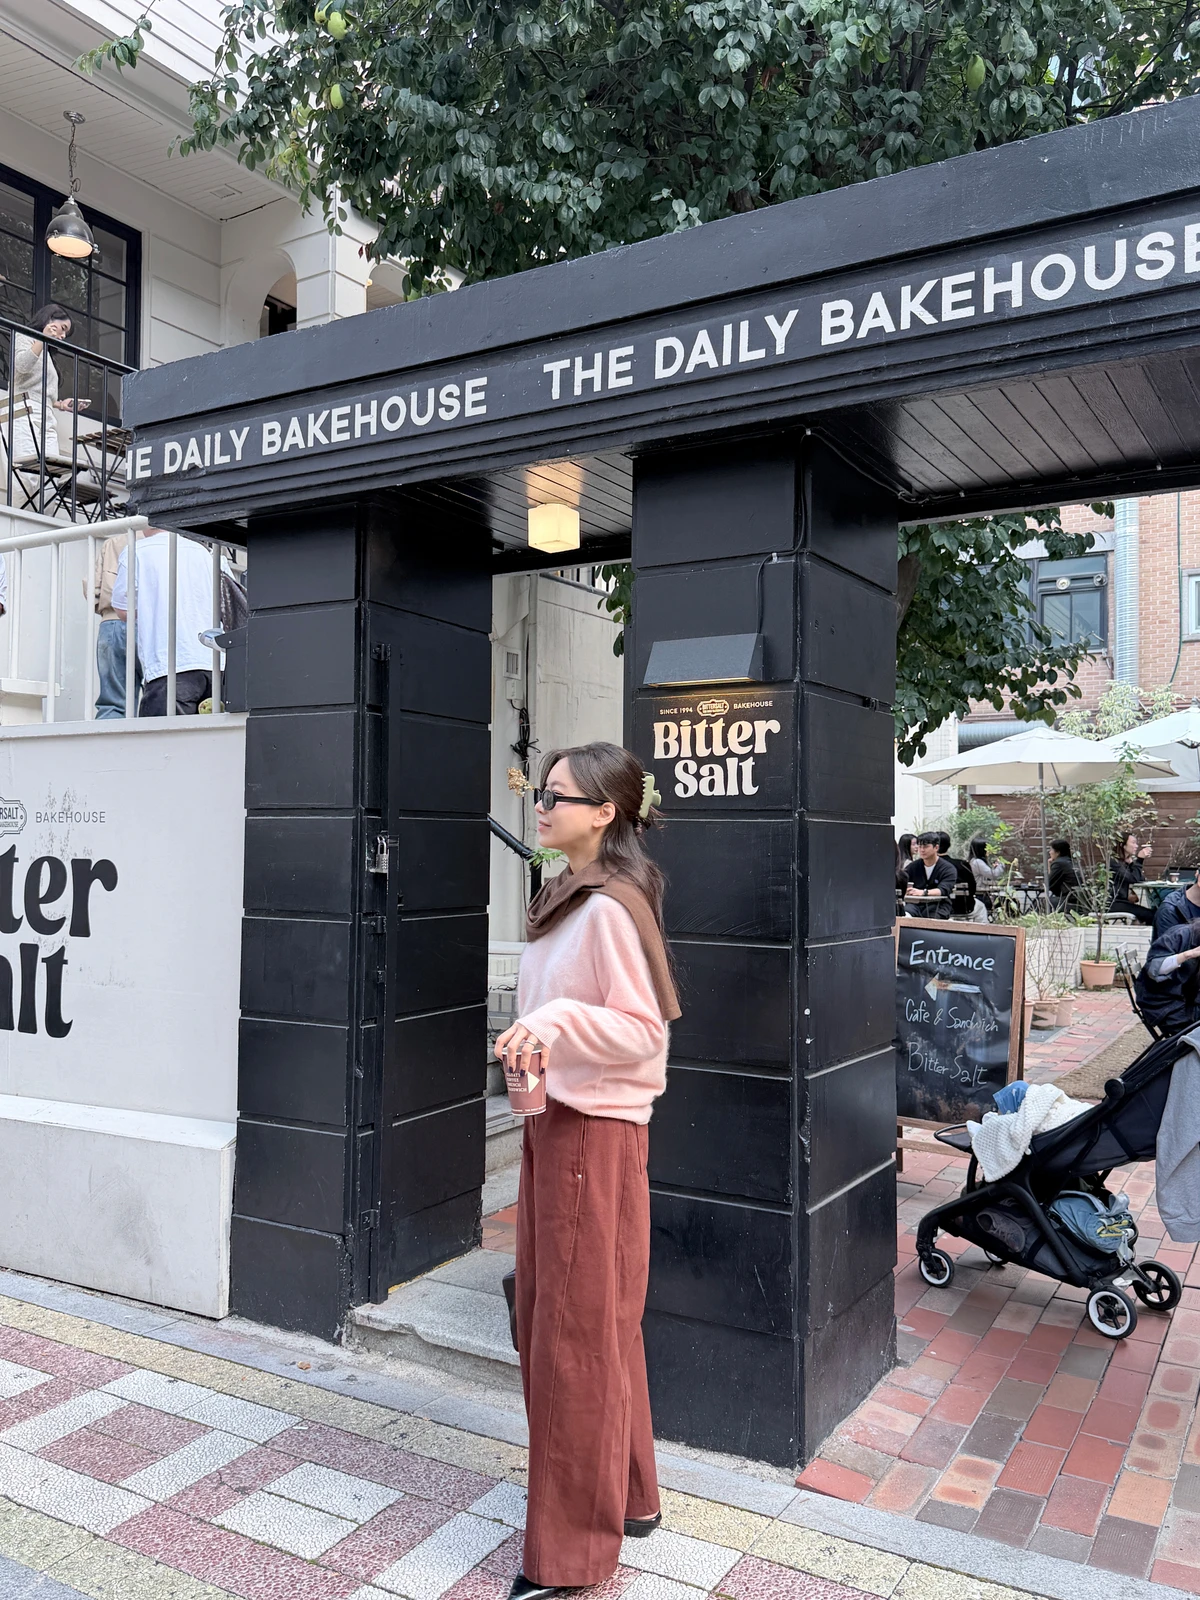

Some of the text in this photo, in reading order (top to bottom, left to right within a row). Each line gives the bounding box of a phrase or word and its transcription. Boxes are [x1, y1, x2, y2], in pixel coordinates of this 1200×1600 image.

[543, 346, 634, 400] THE
[654, 309, 799, 379] DAILY
[164, 427, 250, 474] DAILY
[262, 377, 488, 456] BAKEHOUSE
[733, 701, 773, 710] BAKEHOUSE
[653, 718, 781, 759] Bitter
[674, 756, 759, 798] Salt
[35, 811, 106, 824] BAKEHOUSE
[909, 940, 995, 971] Entrance
[905, 998, 999, 1033] Cafe & Sandwich
[907, 1042, 988, 1087] Bitter Salt
